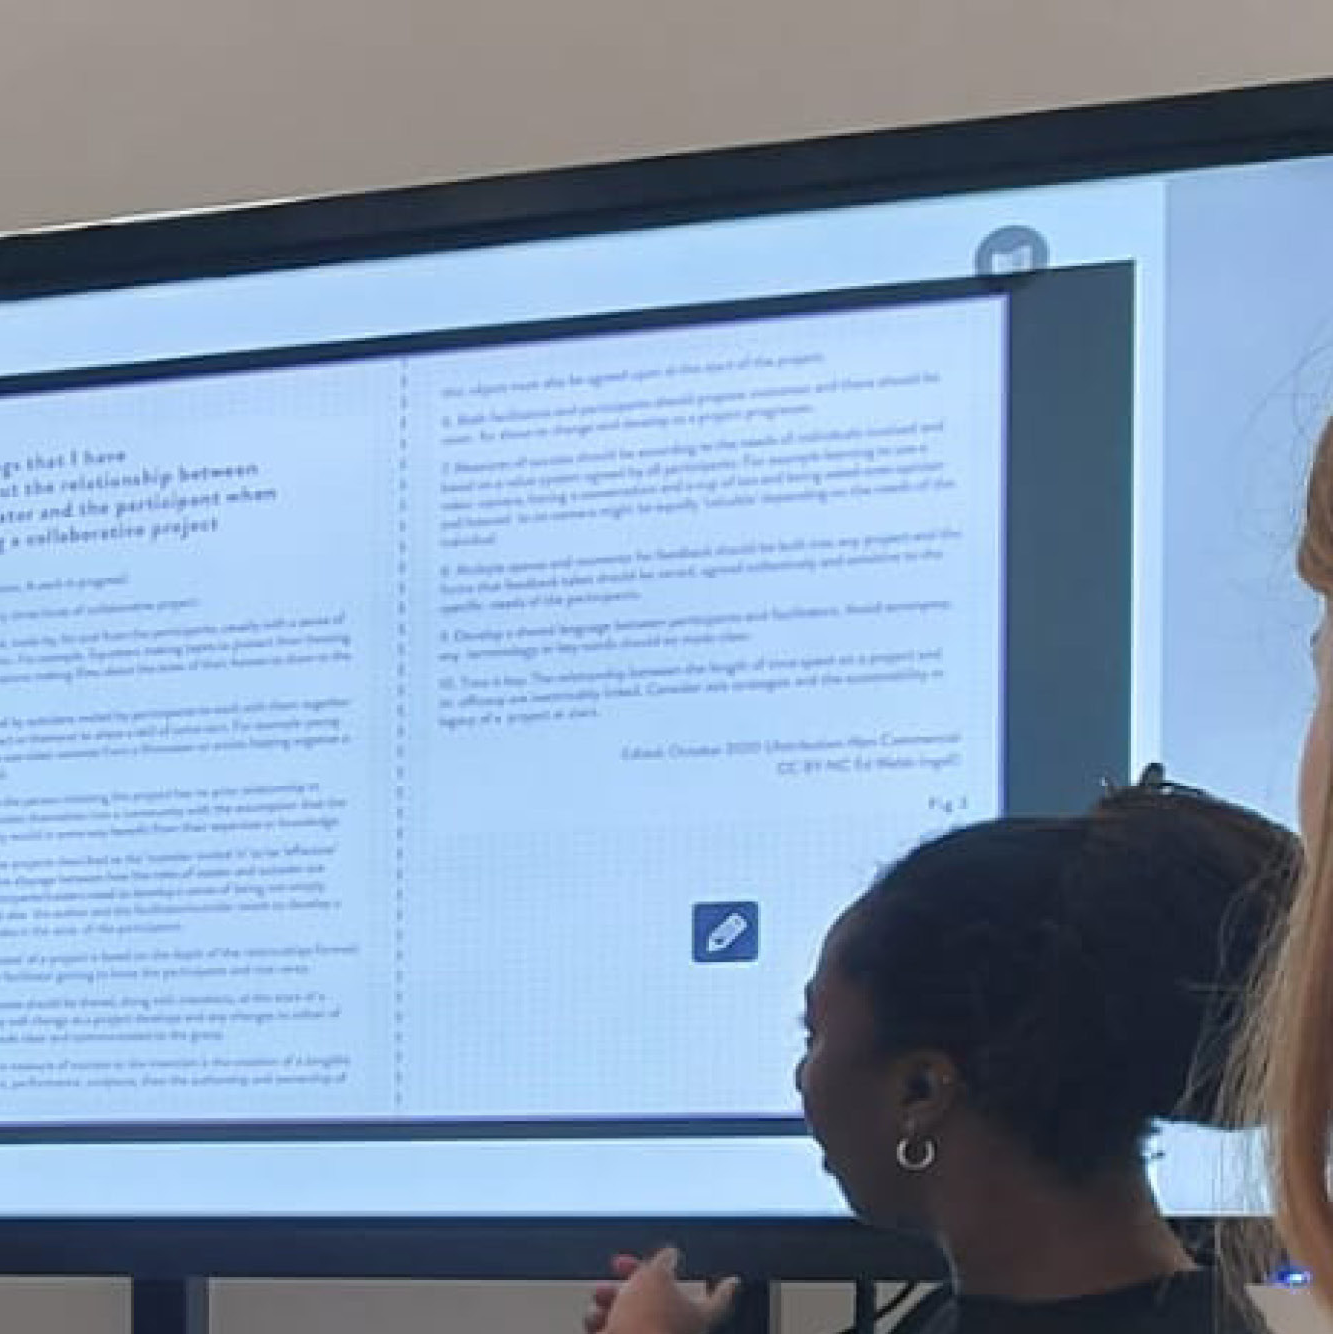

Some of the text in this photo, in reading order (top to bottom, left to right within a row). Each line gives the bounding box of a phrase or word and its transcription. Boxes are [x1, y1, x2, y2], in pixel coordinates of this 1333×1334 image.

[26, 450, 64, 471] that
[83, 449, 127, 466] have
[23, 477, 55, 497] the
[61, 464, 174, 492] relationship
[179, 462, 259, 483] between
[41, 499, 72, 521] and
[78, 495, 109, 517] the
[115, 490, 220, 519] participant
[26, 523, 146, 546] collaborative
[151, 515, 219, 542] project
